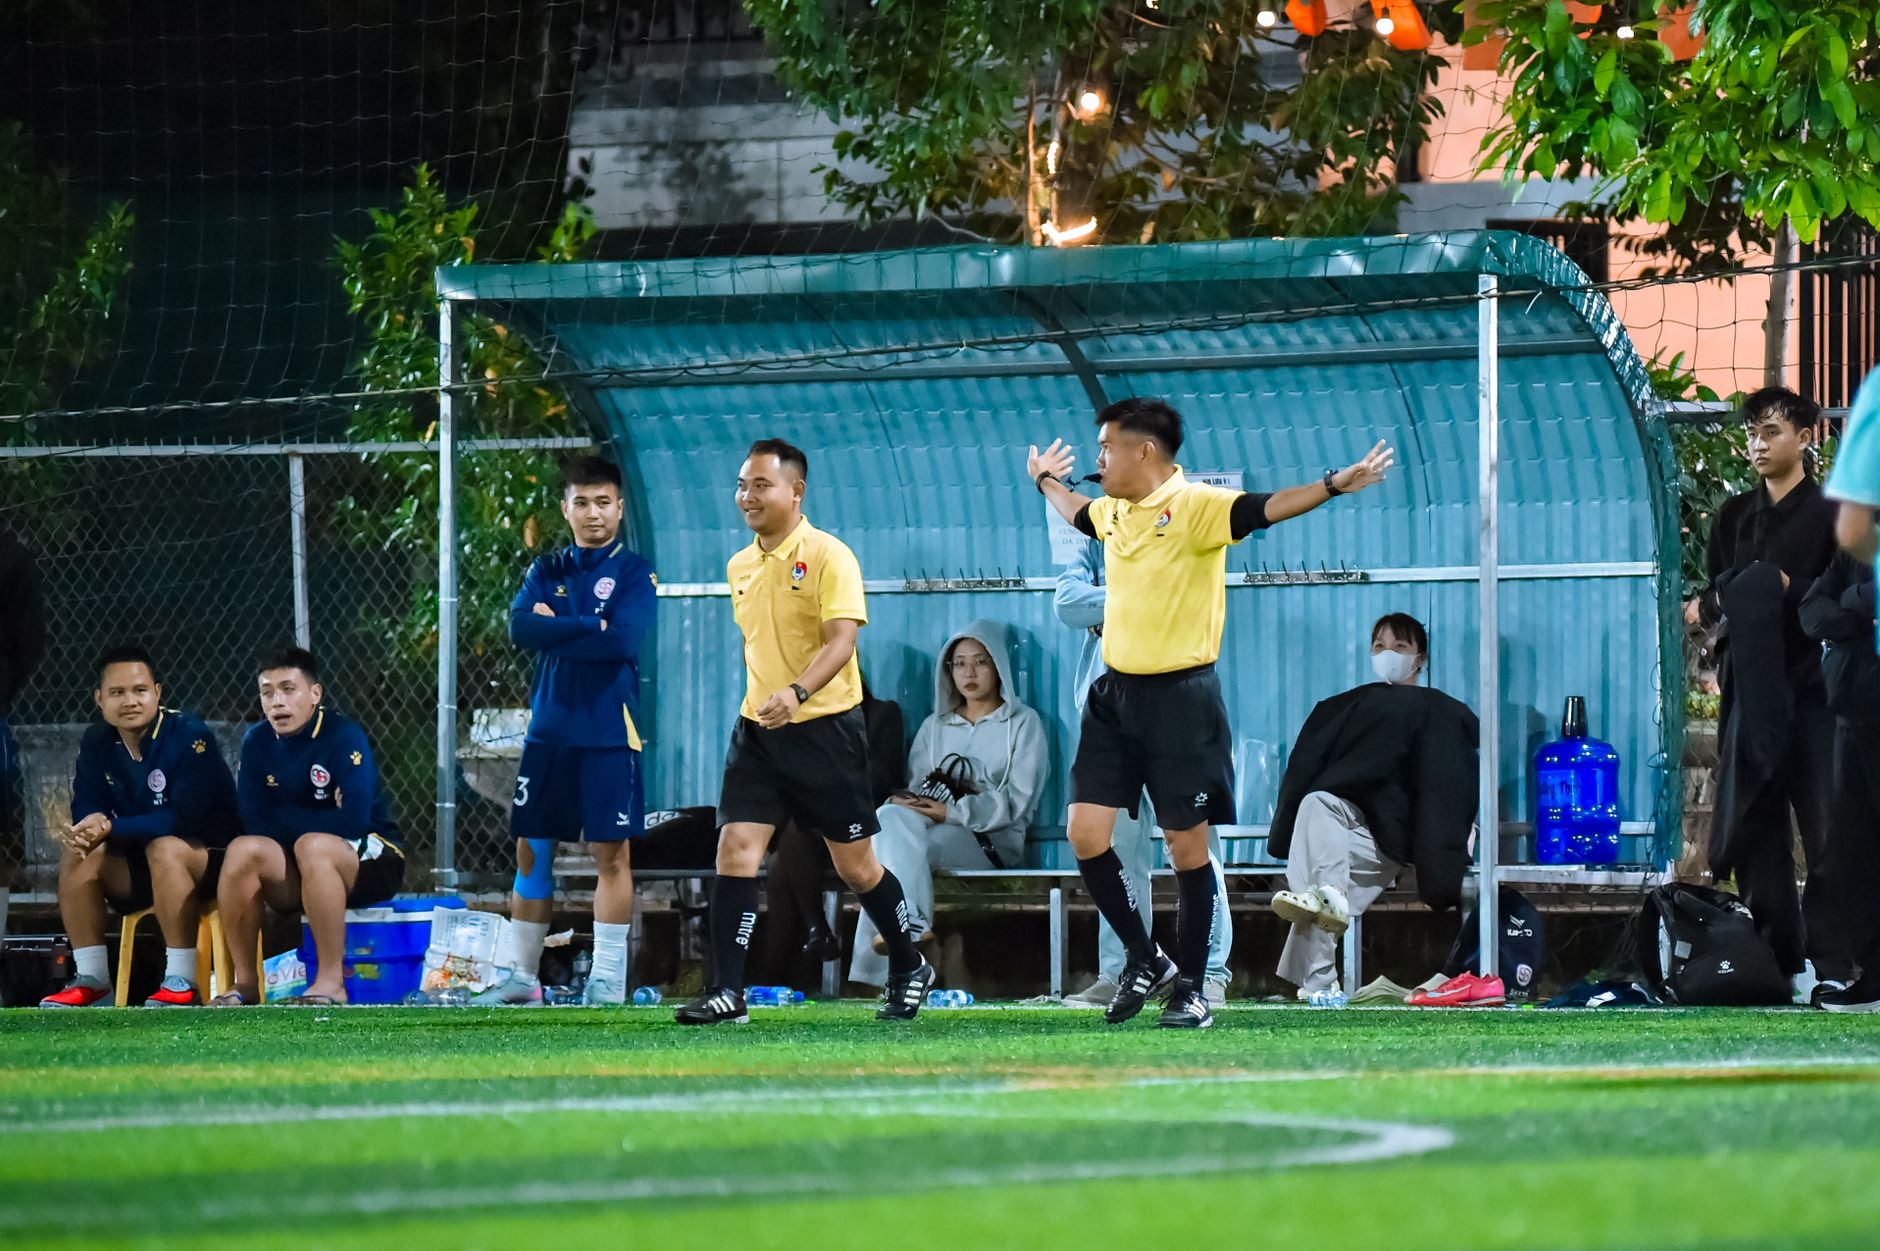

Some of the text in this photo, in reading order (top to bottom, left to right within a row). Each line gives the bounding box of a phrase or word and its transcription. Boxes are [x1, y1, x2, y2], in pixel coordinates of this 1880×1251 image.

[513, 775, 530, 807] 3
[735, 912, 757, 946] mitre
[895, 899, 909, 933] mitre
